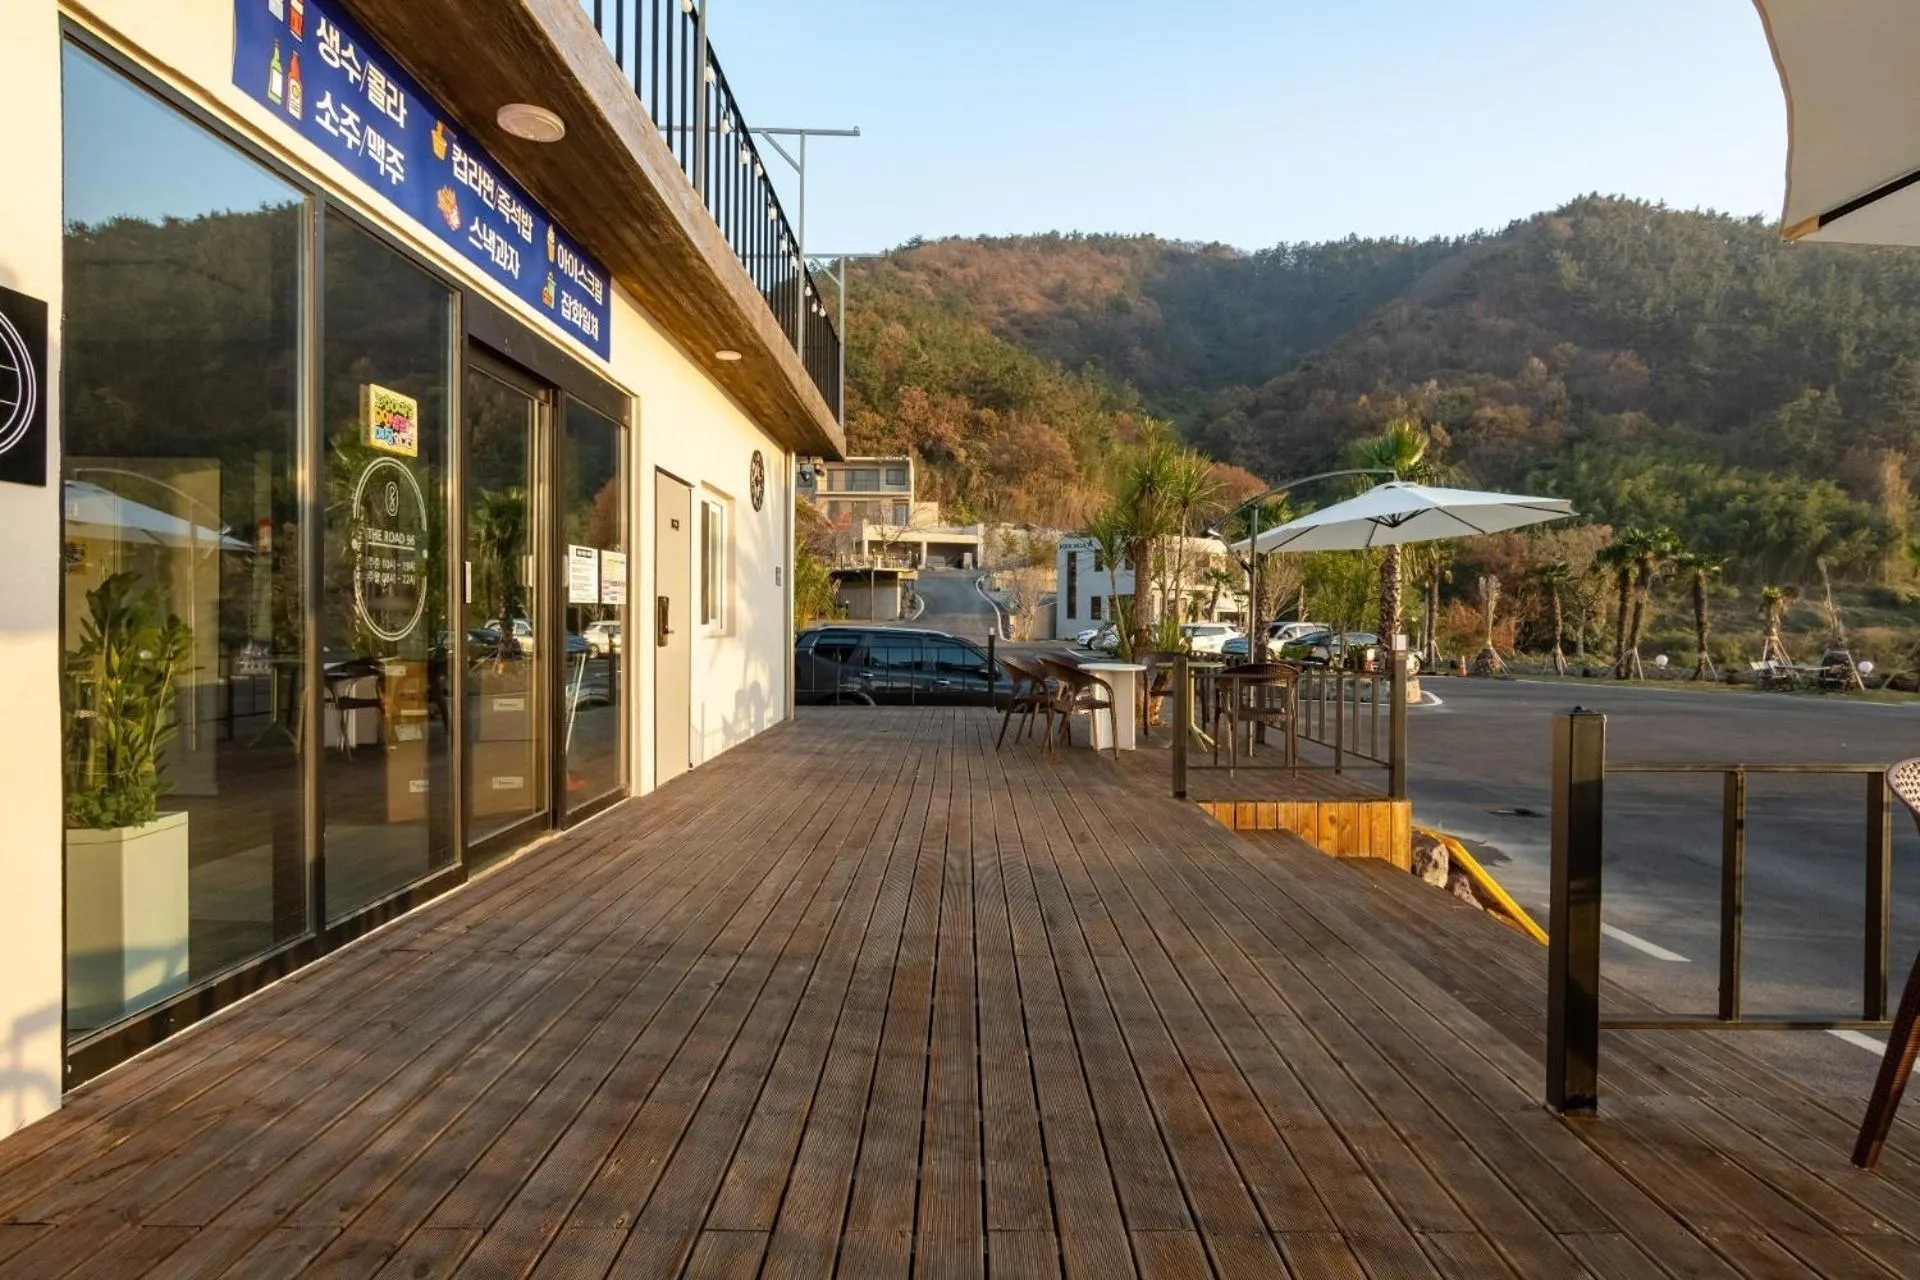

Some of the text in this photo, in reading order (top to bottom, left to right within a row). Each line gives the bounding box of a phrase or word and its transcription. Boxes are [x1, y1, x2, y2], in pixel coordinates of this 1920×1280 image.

[316, 16, 408, 129] 생수/콜라
[315, 90, 405, 186] 소주/맥주
[452, 143, 534, 244] 컵라면/즉석밥
[468, 216, 521, 281] 스낵과자
[557, 244, 603, 306] 아이스크림
[561, 290, 599, 342] 잡화일체
[366, 528, 416, 546] THE ROAD 96
